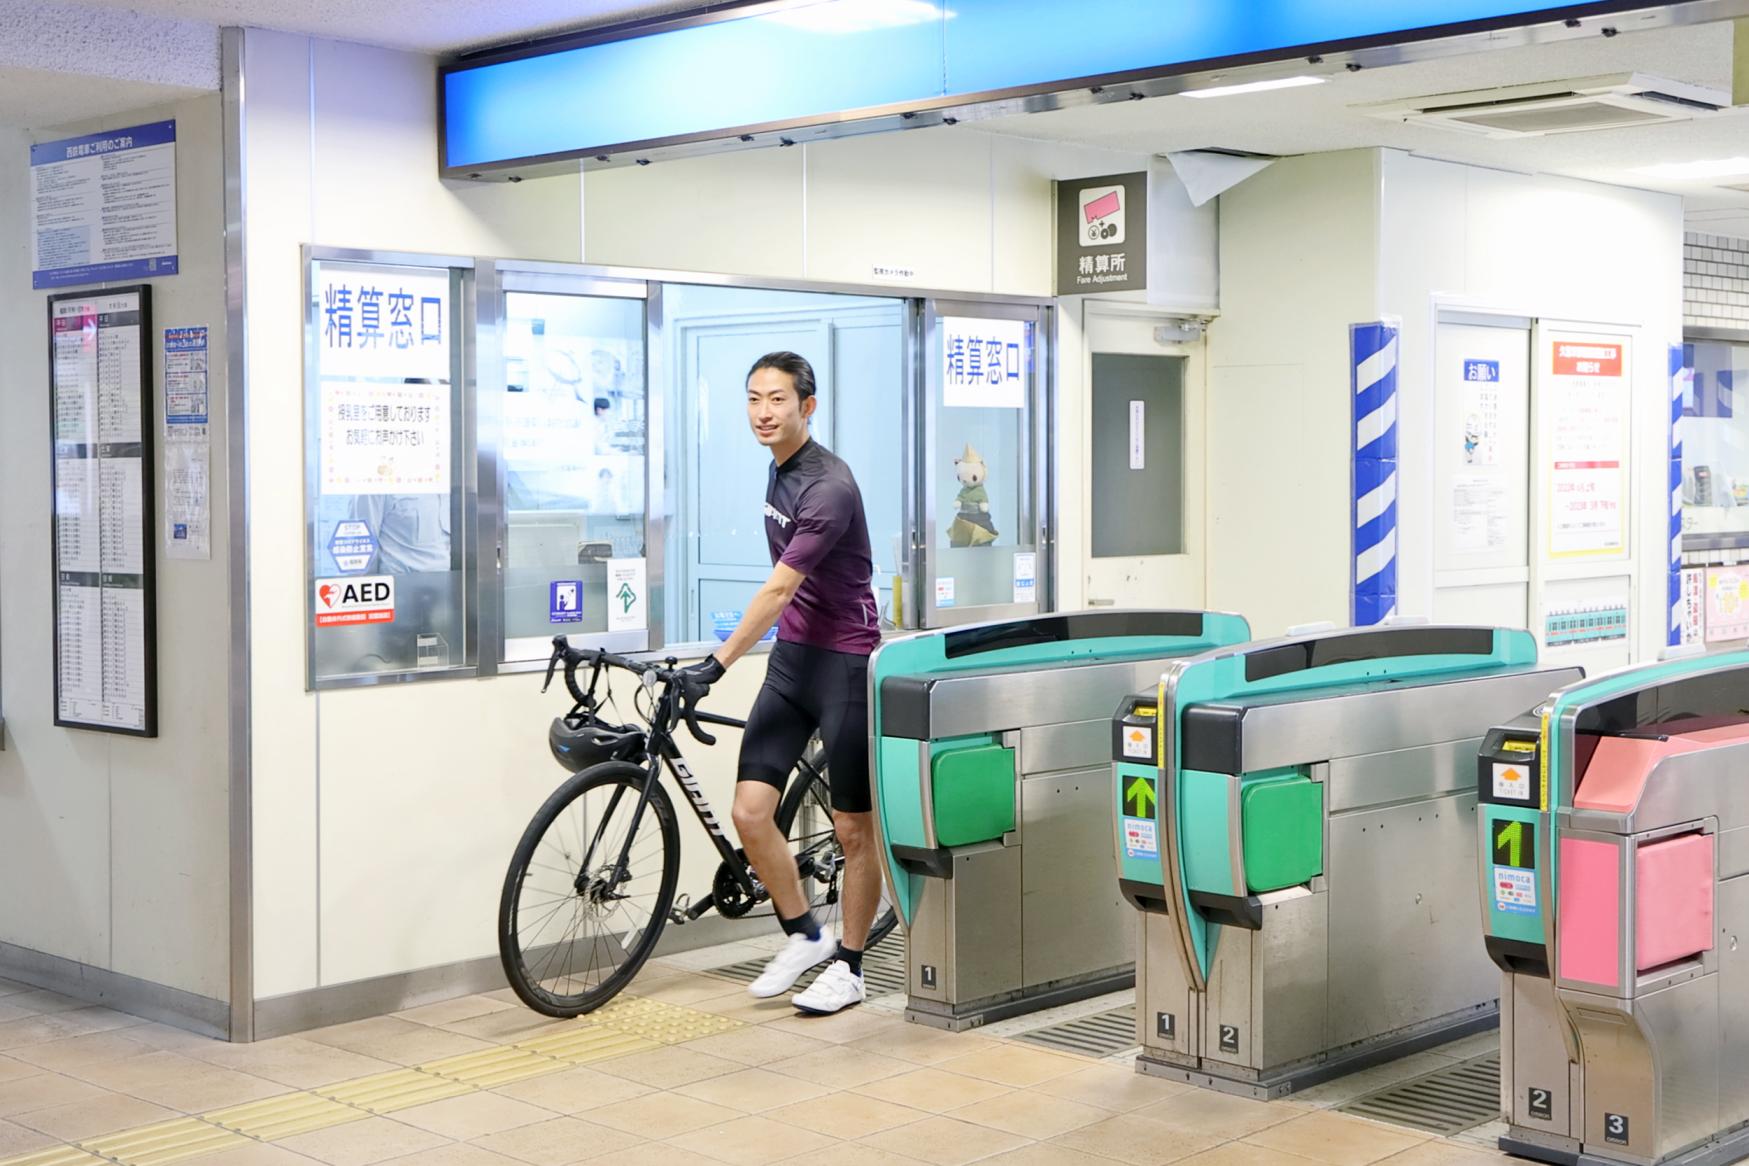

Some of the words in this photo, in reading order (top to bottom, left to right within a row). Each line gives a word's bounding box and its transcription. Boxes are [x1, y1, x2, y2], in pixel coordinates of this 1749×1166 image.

[1079, 253, 1126, 274] 精算所
[1077, 275, 1091, 285] Fare
[1092, 273, 1128, 284] Adjustment
[325, 283, 441, 349] 精算窓口
[947, 334, 1019, 385] 精算窓口
[1468, 362, 1496, 381] お願い
[342, 583, 390, 604] AED
[669, 757, 725, 837] GIANT
[1127, 823, 1152, 832] nimoca
[1498, 872, 1531, 884] nimoca
[924, 967, 932, 981] 1
[1161, 1014, 1170, 1030] 1
[1223, 1026, 1235, 1043] 2
[1532, 1090, 1547, 1109] 2
[1608, 1115, 1624, 1134] 3
